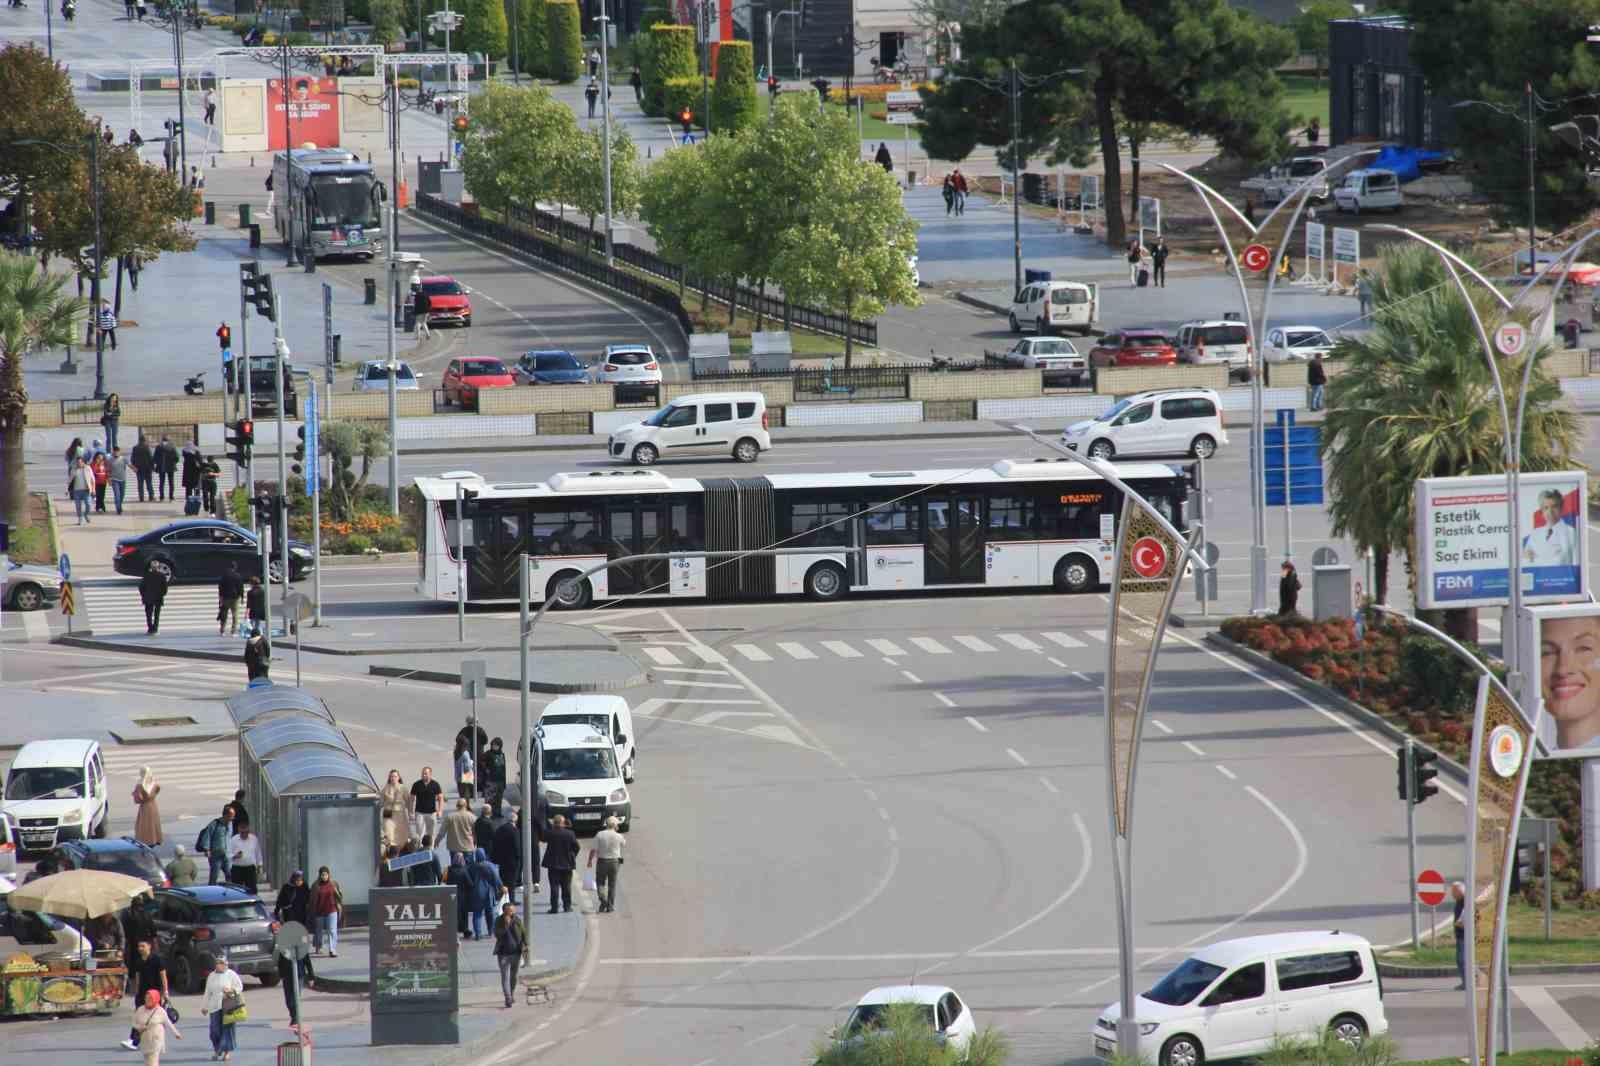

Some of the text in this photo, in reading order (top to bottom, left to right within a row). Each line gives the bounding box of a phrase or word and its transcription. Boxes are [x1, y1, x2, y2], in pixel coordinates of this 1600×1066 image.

[1435, 509, 1480, 523] Estetik
[1435, 524, 1511, 537] Plastik Cerra
[1435, 547, 1497, 564] Saç Ekimi
[1436, 574, 1473, 589] FBM
[384, 903, 442, 920] YALI
